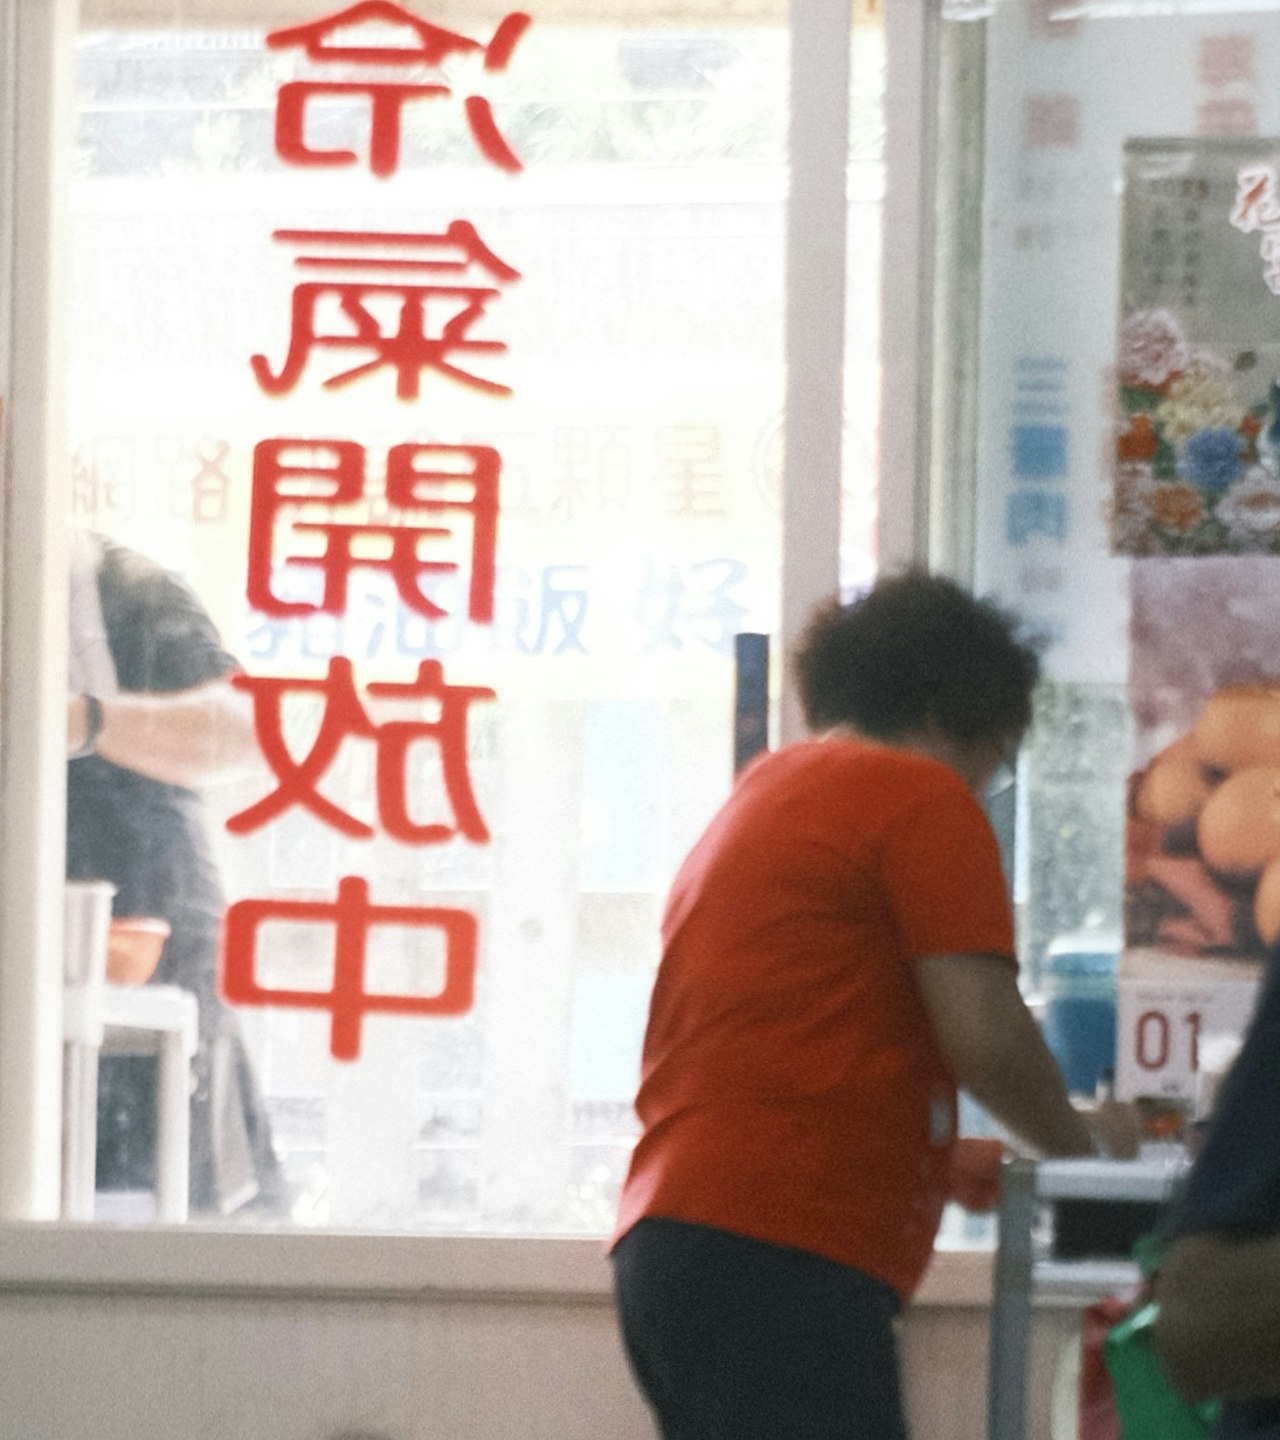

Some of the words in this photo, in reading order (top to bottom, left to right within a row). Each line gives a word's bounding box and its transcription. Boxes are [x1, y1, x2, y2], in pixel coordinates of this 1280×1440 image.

[69, 423, 729, 526] 網路五顆星
[1134, 1008, 1202, 1073] 01
